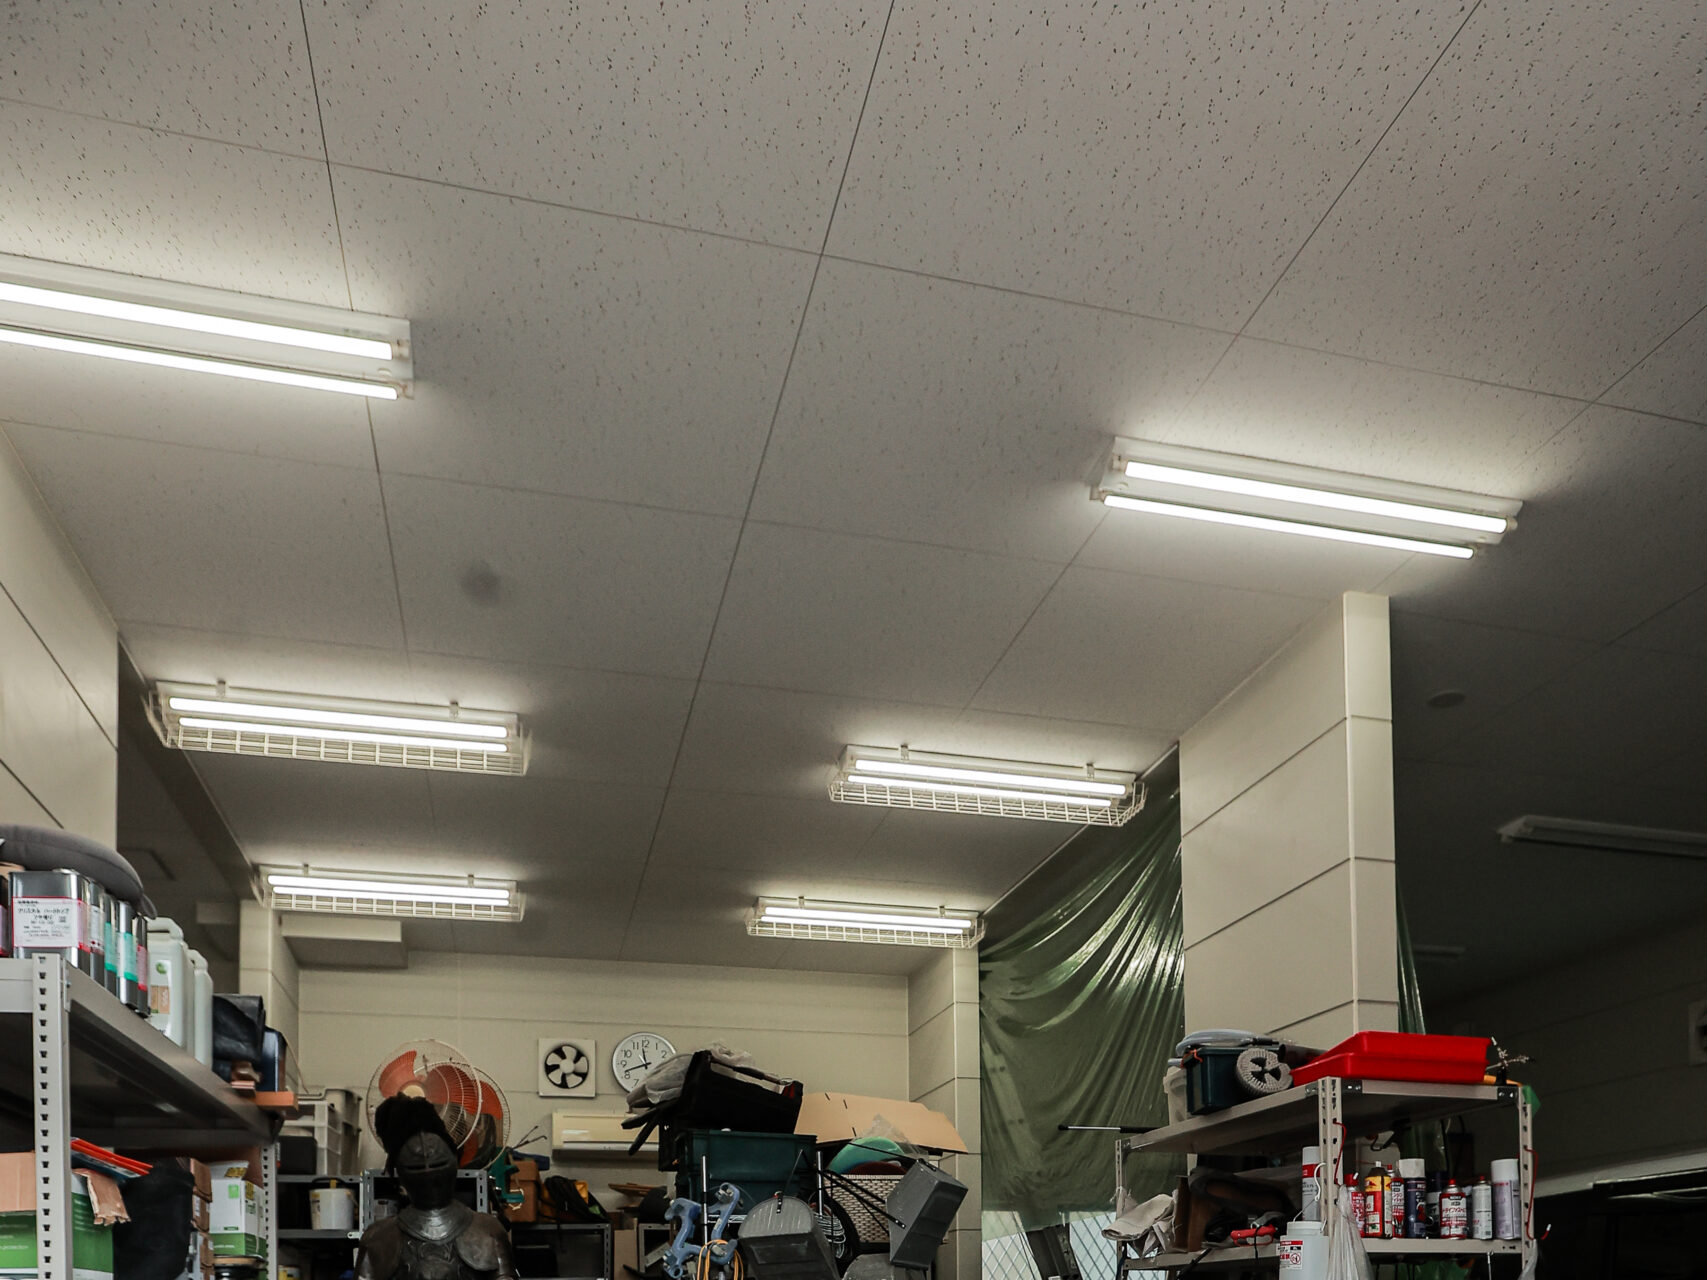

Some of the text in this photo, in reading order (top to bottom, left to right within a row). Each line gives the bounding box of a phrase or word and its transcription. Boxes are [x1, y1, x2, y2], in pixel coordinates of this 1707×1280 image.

[632, 1042, 640, 1050] 11
[641, 1039, 650, 1048] 12
[623, 1049, 632, 1058] 10
[661, 1050, 668, 1058] 2
[620, 1060, 627, 1068] 9
[624, 1071, 631, 1080] 8
[633, 1079, 640, 1087] 7
